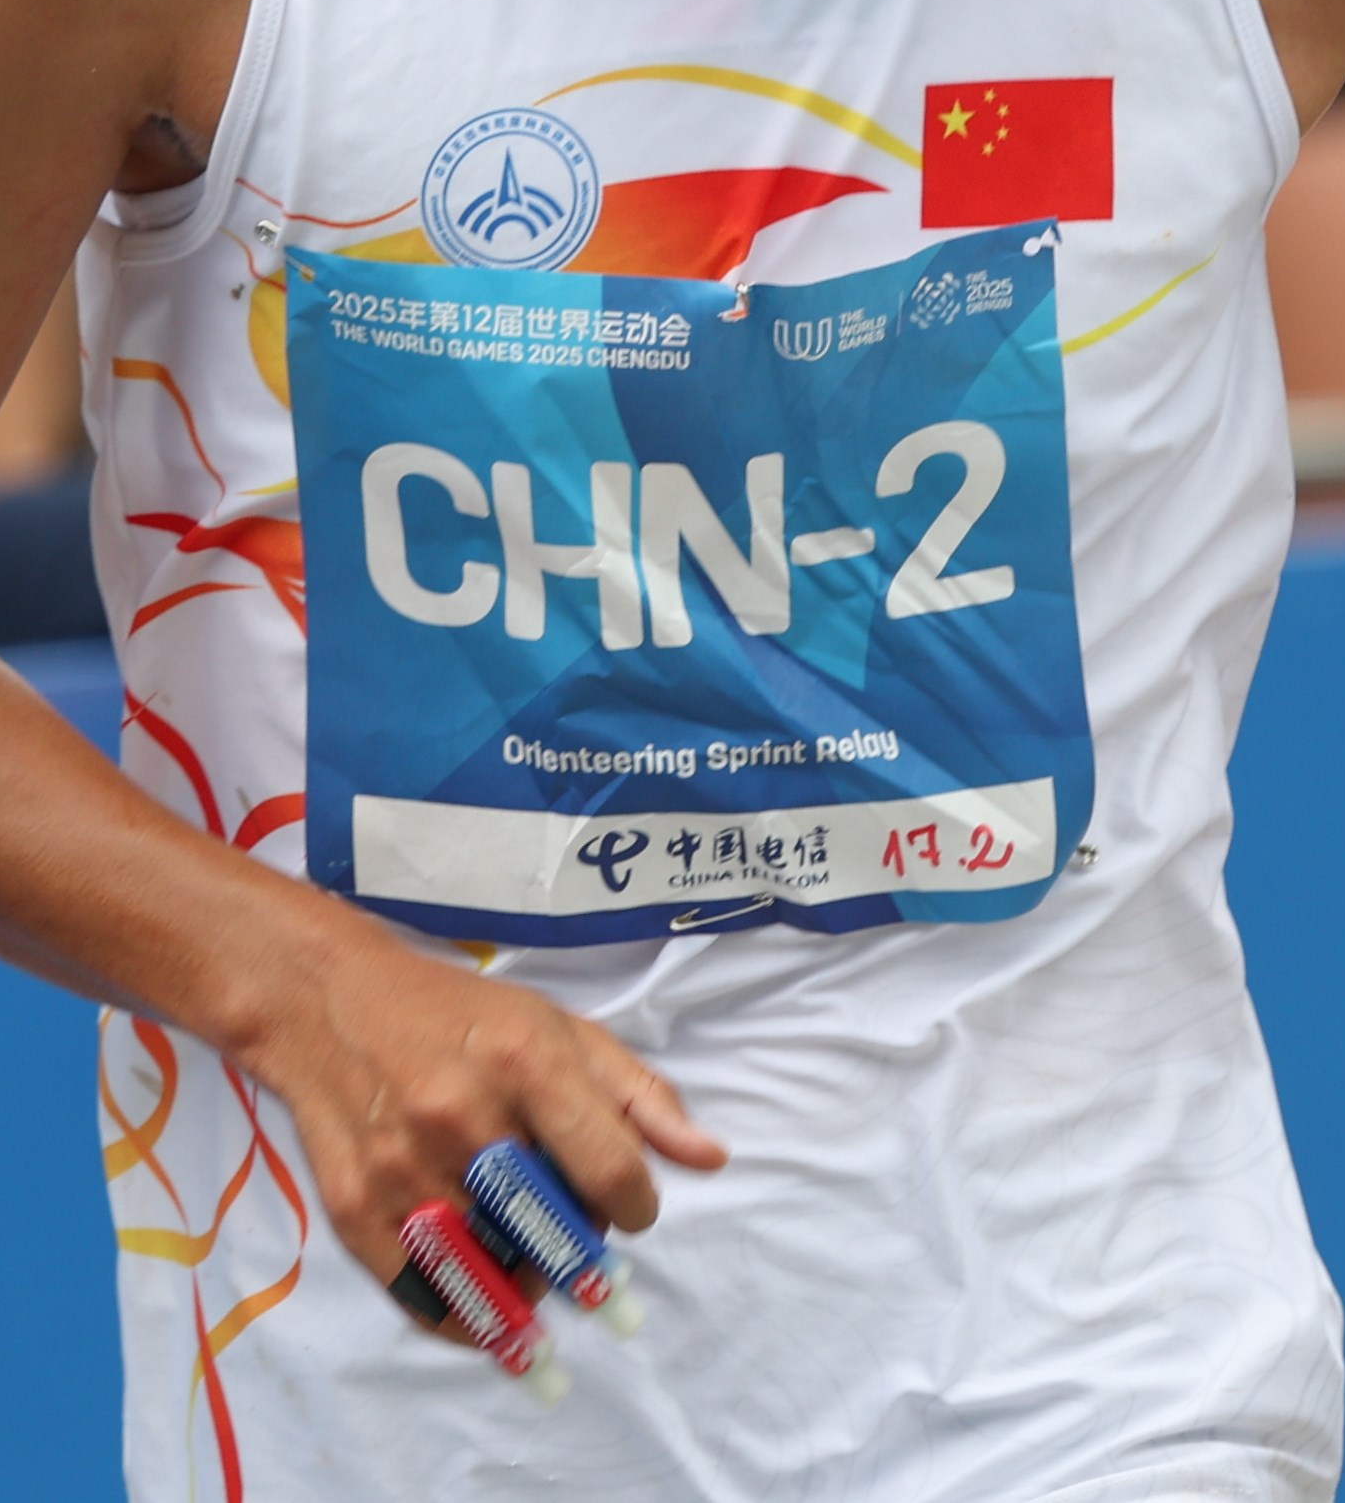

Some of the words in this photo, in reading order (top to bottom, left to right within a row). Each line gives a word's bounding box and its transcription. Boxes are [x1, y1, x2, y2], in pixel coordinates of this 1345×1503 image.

[966, 277, 1013, 302] 2025
[328, 288, 691, 346] 2025年第12届世界运动会
[838, 307, 866, 326] THE
[838, 314, 888, 339] WORLD
[331, 319, 368, 344] THE
[370, 328, 444, 357] WORLD
[447, 338, 524, 363] GAMES
[528, 342, 583, 366] 2025
[587, 346, 691, 370] CHENGDU
[838, 328, 886, 353] GAMES
[360, 419, 1015, 651] CHN-2
[502, 734, 696, 779] Orienteering
[706, 740, 807, 774] Sprint
[815, 728, 901, 763] Relay
[665, 825, 830, 872] 中国电信
[882, 823, 1015, 877] 17.2
[668, 867, 734, 889] CHINA
